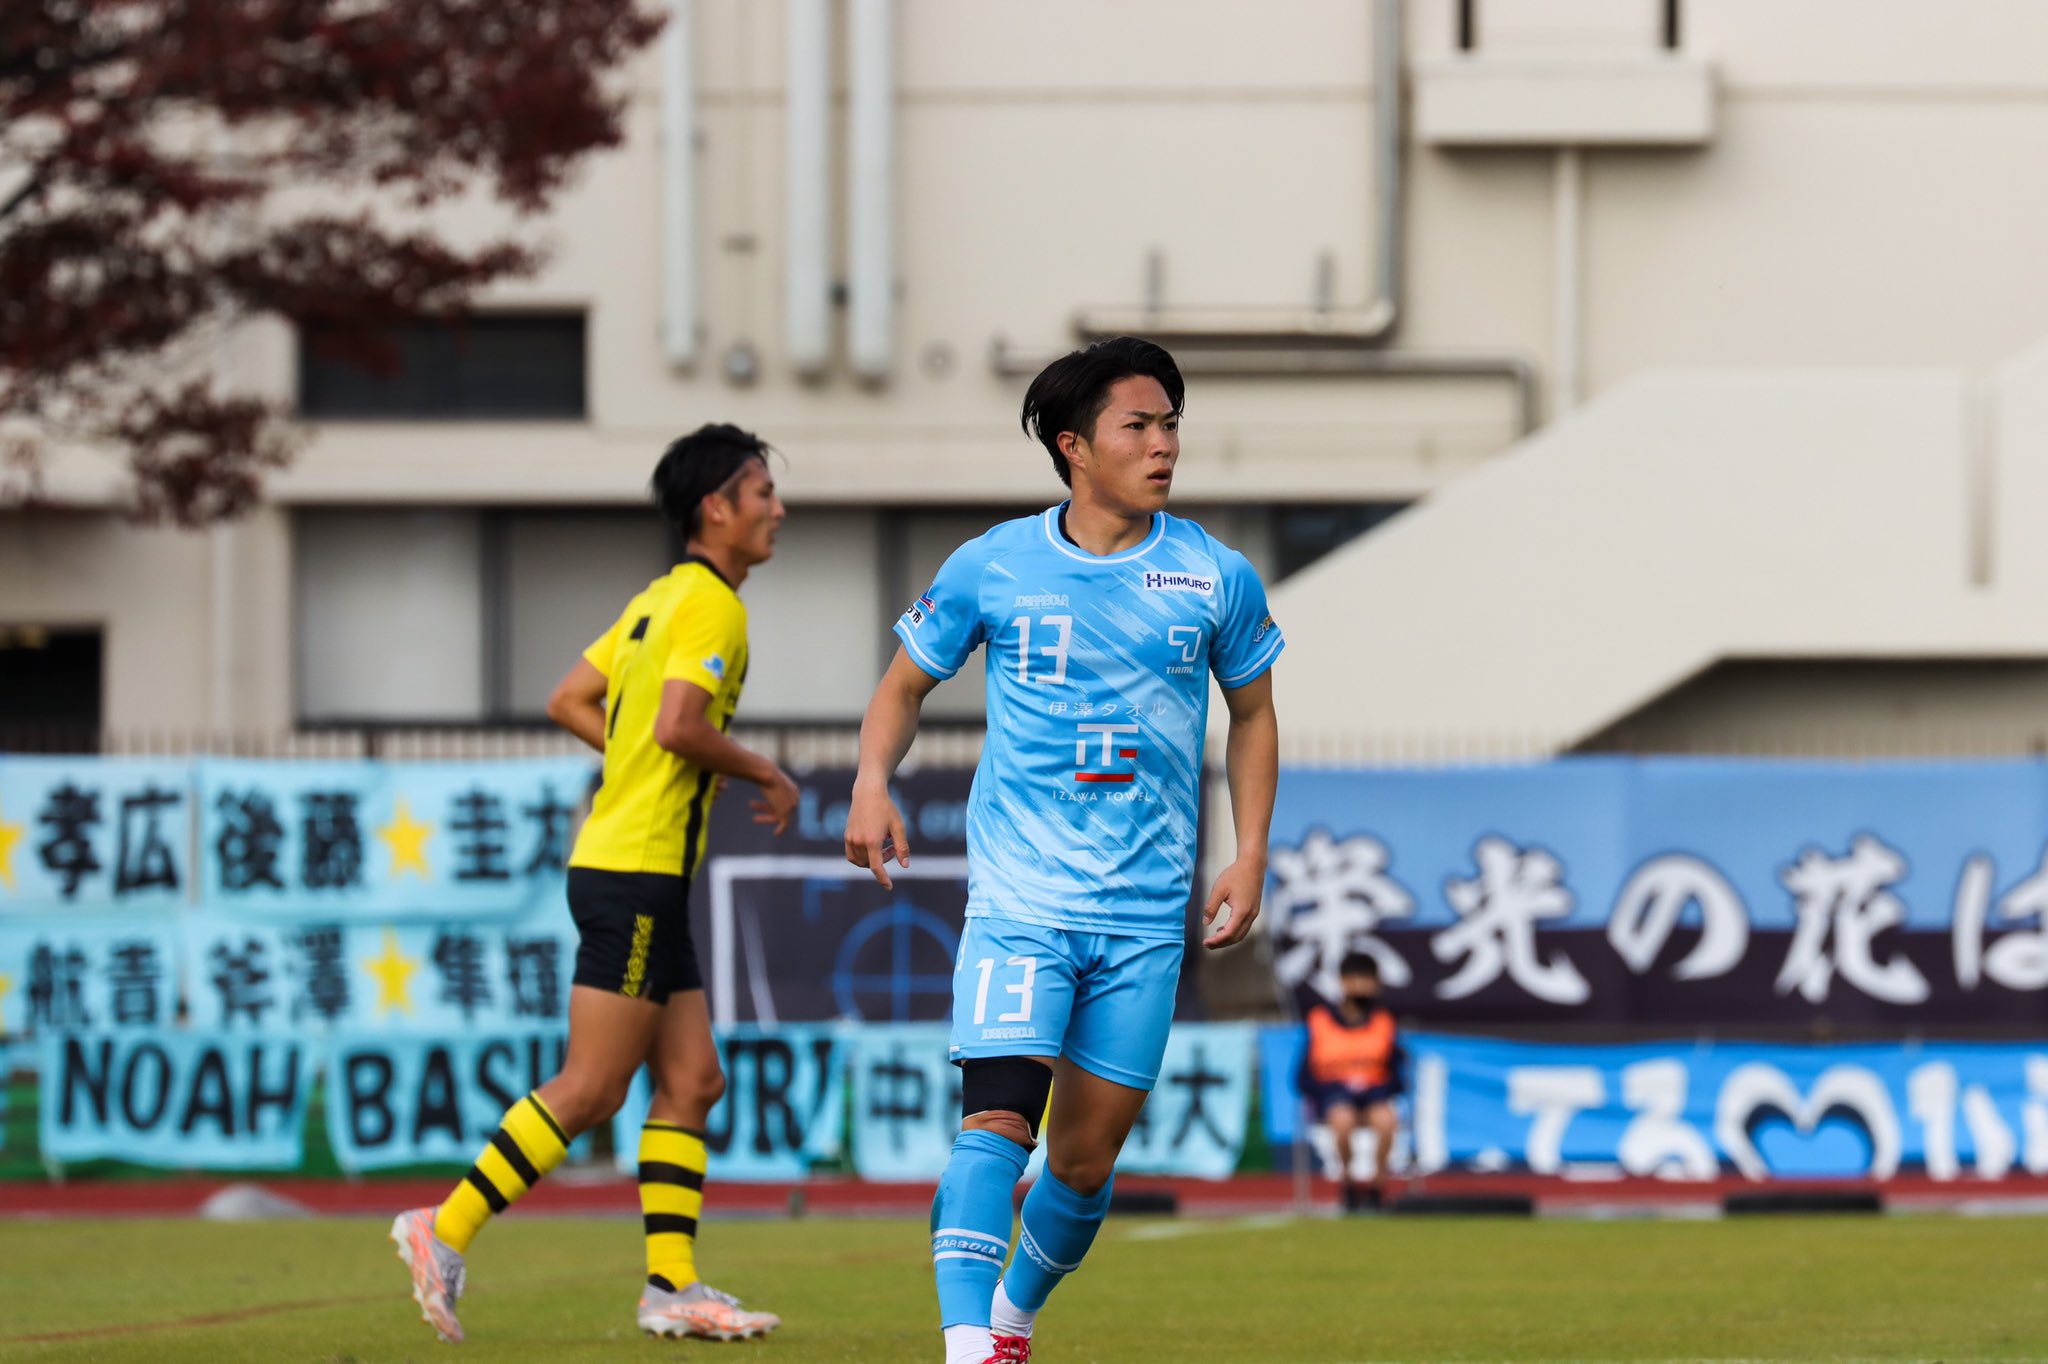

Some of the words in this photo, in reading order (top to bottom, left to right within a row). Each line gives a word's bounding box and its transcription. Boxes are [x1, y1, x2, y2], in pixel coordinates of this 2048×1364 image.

[1163, 576, 1212, 591] HIMURO
[1011, 615, 1073, 685] 13
[1048, 701, 1167, 717] 伊澤タオル
[1053, 790, 1098, 801] IZAWA
[1105, 791, 1151, 801] TOWEL
[974, 956, 1036, 1025] 13
[58, 1036, 300, 1138] NOAH
